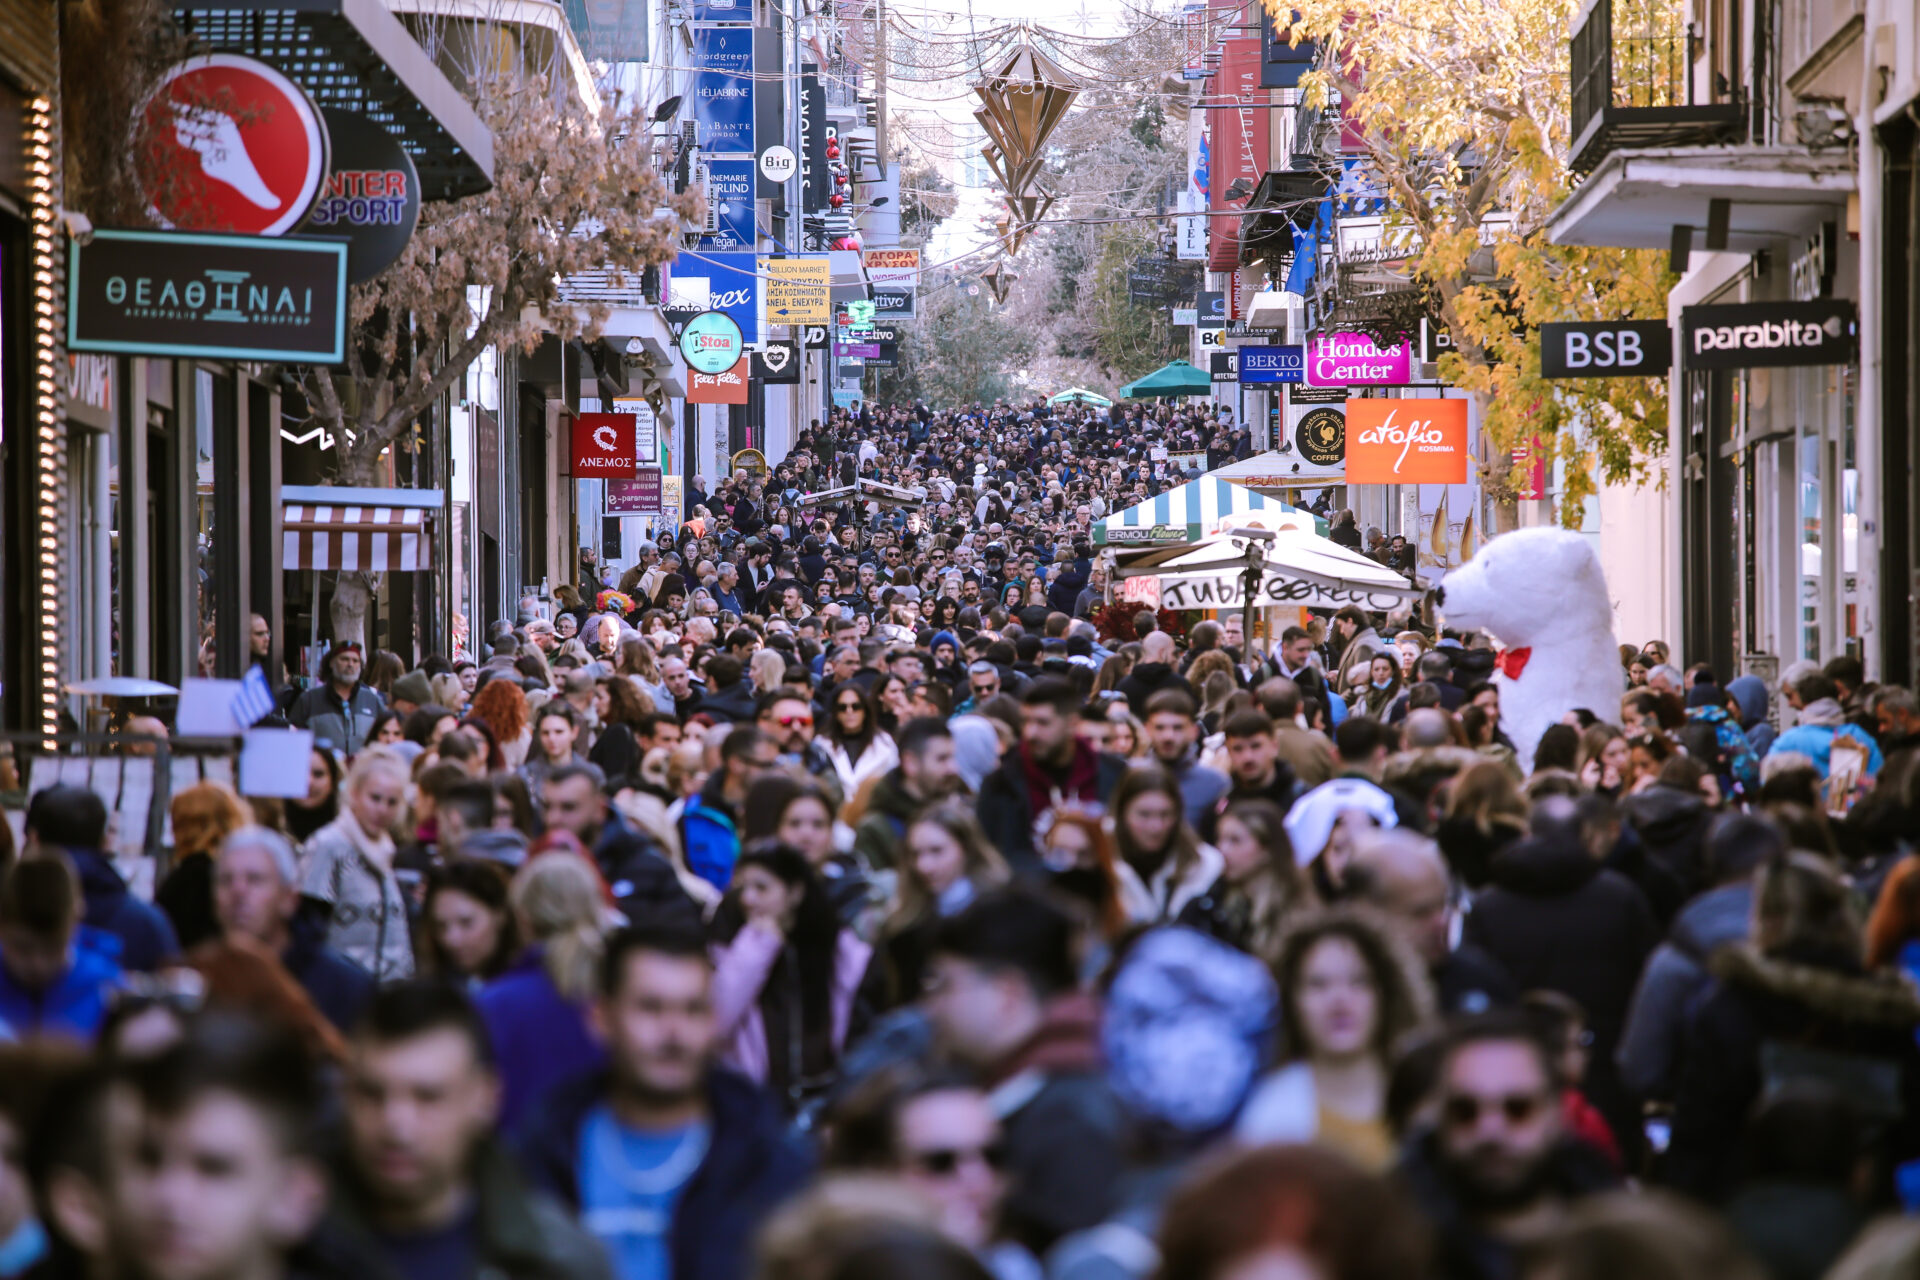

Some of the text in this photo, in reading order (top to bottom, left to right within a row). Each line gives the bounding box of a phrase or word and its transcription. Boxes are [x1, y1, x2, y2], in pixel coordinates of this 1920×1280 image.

[697, 52, 750, 62] nordgreen
[765, 156, 790, 170] Big
[311, 199, 407, 226] SPORT
[870, 251, 913, 260] ΑΓΟΡΑ
[792, 299, 824, 307] ΕΝΕΧΥΡΑ
[1694, 319, 1823, 354] parabita
[1316, 337, 1401, 358] Hondos
[1566, 331, 1644, 368] BSB
[1246, 355, 1300, 367] BERTO
[1316, 358, 1393, 380] Center
[694, 373, 742, 388] Folli Follie
[1418, 445, 1455, 453] KOSMIMA
[579, 457, 632, 468] ΑΝΕΜΟΣ
[608, 494, 658, 505] e-paramana
[1107, 526, 1188, 540] ERMOU Flower
